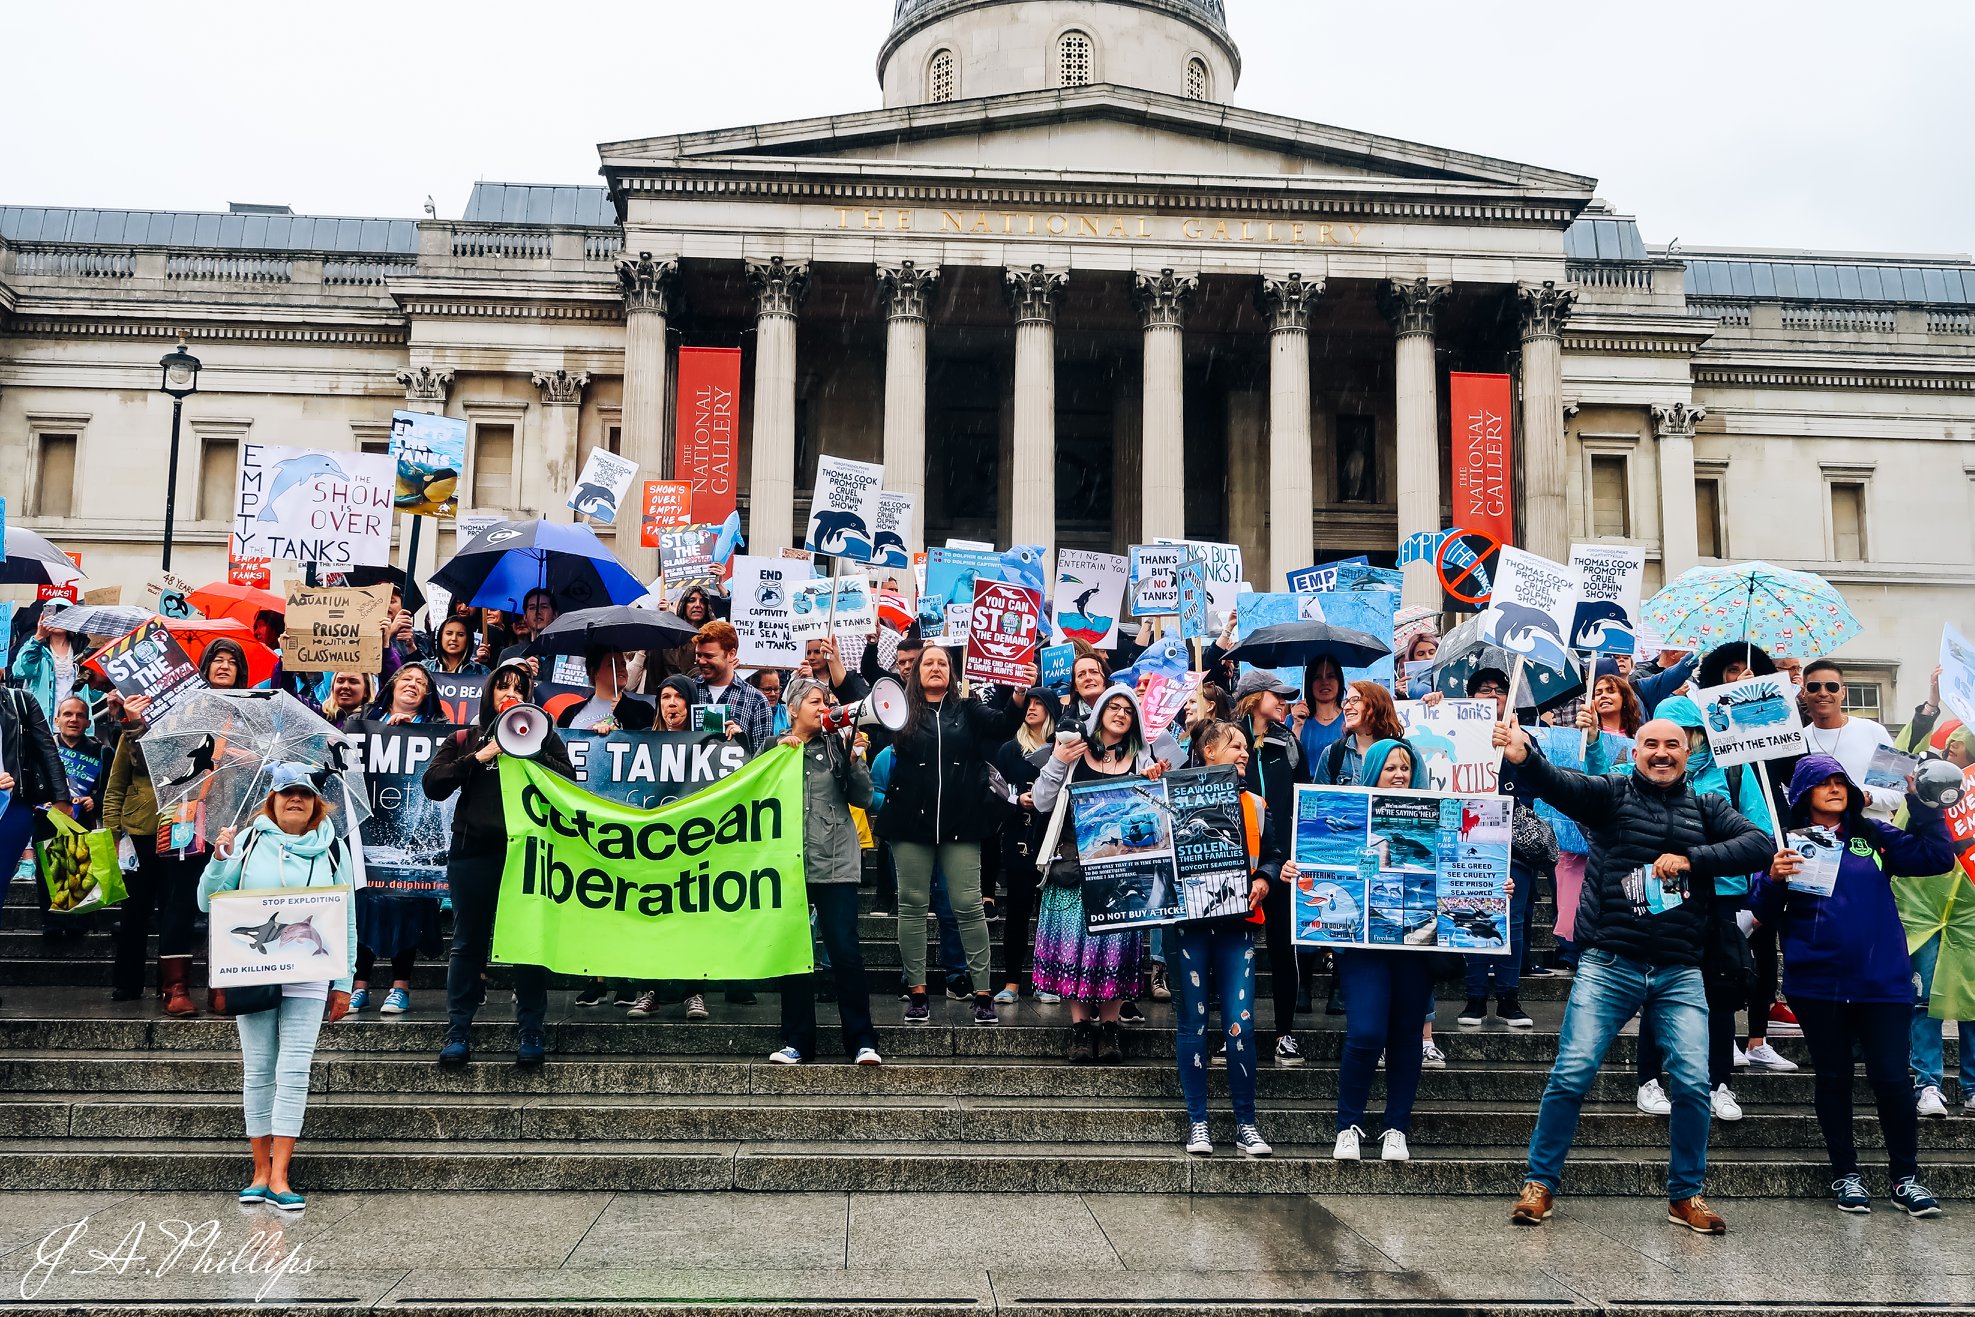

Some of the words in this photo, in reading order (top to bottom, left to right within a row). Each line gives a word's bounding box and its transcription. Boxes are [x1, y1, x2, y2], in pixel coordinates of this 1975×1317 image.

[834, 208, 912, 230] THE
[940, 211, 1153, 238] NATIONAL
[1183, 218, 1365, 245] GALLERY
[394, 421, 453, 441] EMPTY
[693, 385, 712, 494] NATIONAL
[711, 386, 732, 495] GALLERY
[390, 447, 451, 466] TANKS
[684, 444, 692, 466] THE
[592, 455, 615, 469] THOMAS
[615, 464, 632, 475] COOK
[1468, 409, 1484, 516] NATIONAL
[1486, 410, 1504, 517] GALLERY
[597, 463, 624, 478] PROMOTE
[601, 469, 616, 480] CRUEL
[822, 468, 853, 481] THOMAS
[854, 474, 878, 486] COOK
[355, 475, 371, 483] THE
[594, 472, 618, 485] DOLPHIN
[594, 479, 614, 489] SHOWS
[829, 478, 867, 491] PROMOTE
[312, 482, 391, 508] SHOW
[650, 485, 685, 495] SHOW'S
[835, 486, 858, 497] CRUEL
[235, 444, 264, 555] EMPTY
[651, 495, 681, 504] OVER!
[829, 493, 862, 505] DOLPHIN
[830, 500, 858, 512] SHOWS
[892, 502, 911, 510] COOK
[649, 505, 683, 514] EMPTY
[311, 510, 380, 536] OVER
[655, 515, 676, 525] THE
[250, 546, 265, 554] THE
[268, 536, 350, 563] TANKS
[673, 545, 701, 558] THE
[1211, 546, 1238, 564] BUT
[1059, 550, 1099, 561] DYING
[1109, 556, 1122, 564] TO
[1139, 555, 1178, 565] THANKS
[1574, 557, 1610, 569] THOMAS
[1611, 560, 1639, 570] COOK
[240, 562, 258, 570] THE
[1058, 560, 1106, 571] ENTERTAIN
[1112, 564, 1126, 574] YOU
[1151, 568, 1169, 577] BUT
[1205, 563, 1239, 583] NKS!
[1446, 538, 1478, 569] THE
[1473, 562, 1493, 597] TANKS
[1583, 566, 1626, 576] PROMOTE
[232, 572, 265, 580] TANKS!
[760, 570, 782, 580] END
[1296, 570, 1335, 590] EMP
[1505, 559, 1545, 578] THOMAS
[1547, 573, 1574, 590] COOK
[1515, 570, 1561, 593] PROMOTE
[1590, 575, 1616, 583] CRUEL
[163, 574, 176, 586] 48
[175, 578, 196, 594] YEARS
[1153, 580, 1167, 588] NO
[1523, 581, 1551, 596] CRUEL
[1583, 582, 1622, 592] DOLPHIN
[41, 587, 73, 598] TANKS!
[287, 593, 350, 606] AQUARIUM
[1142, 591, 1177, 601] TANKS!
[1515, 585, 1556, 605] DOLPHIN
[1585, 591, 1618, 600] SHOWS
[985, 595, 1005, 608] YOU
[1008, 599, 1029, 612] CAN
[1517, 594, 1551, 612] SHOWS
[749, 608, 788, 617] CAPTIVITY
[313, 622, 360, 638] PRISON
[734, 619, 755, 628] THEY
[758, 621, 789, 630] BELONG
[792, 622, 822, 632] EMPTY
[843, 617, 872, 626] TANKS
[736, 628, 755, 636] THE
[760, 630, 778, 639] SEA
[976, 630, 993, 641] THE
[994, 632, 1030, 647] DEMAND
[754, 641, 764, 649] IN
[766, 641, 797, 651] TANKS
[968, 656, 982, 664] HELP
[1052, 658, 1065, 669] NO
[131, 655, 173, 688] THE
[973, 663, 992, 672] DRIVE
[993, 667, 1014, 676] HUNTS
[154, 699, 164, 708] US
[162, 690, 176, 702] END
[174, 672, 201, 695] CAPTIVITY
[436, 685, 456, 697] NO
[460, 686, 483, 698] BEA
[144, 715, 151, 723] &
[150, 702, 170, 718] DRIVE
[1415, 702, 1440, 720] The
[1448, 702, 1492, 720] Tanks
[1713, 742, 1745, 756] EMPTY
[1746, 738, 1765, 750] THE
[1766, 732, 1801, 746] TANKS
[346, 733, 453, 775] EMP
[606, 742, 745, 783] TANKS
[1452, 762, 1498, 793] KILLS
[372, 781, 415, 811] let
[1173, 782, 1234, 796] SEAWORLD
[1174, 790, 1238, 808] SLAVES
[1948, 793, 1975, 819] OVE
[1375, 808, 1396, 816] WE'RE
[1396, 810, 1418, 818] SAYING
[521, 784, 782, 861] cetacean
[1178, 842, 1228, 856] STOLEN
[1179, 853, 1203, 863] THEIR
[1205, 849, 1244, 860] FAMILIES
[1180, 863, 1208, 871] BOYCOTT
[1210, 859, 1245, 868] SEAWORLD
[522, 835, 783, 917] liberation
[262, 898, 285, 906] STOP
[288, 896, 341, 905] EXPLOITING
[1090, 913, 1105, 923] DO
[1107, 911, 1127, 921] NOT
[1128, 909, 1147, 918] BUY
[1150, 908, 1157, 916] A
[1159, 905, 1187, 916] TICKE
[1311, 920, 1320, 928] NO
[241, 965, 277, 973] KILLING
[279, 963, 295, 971] US!
